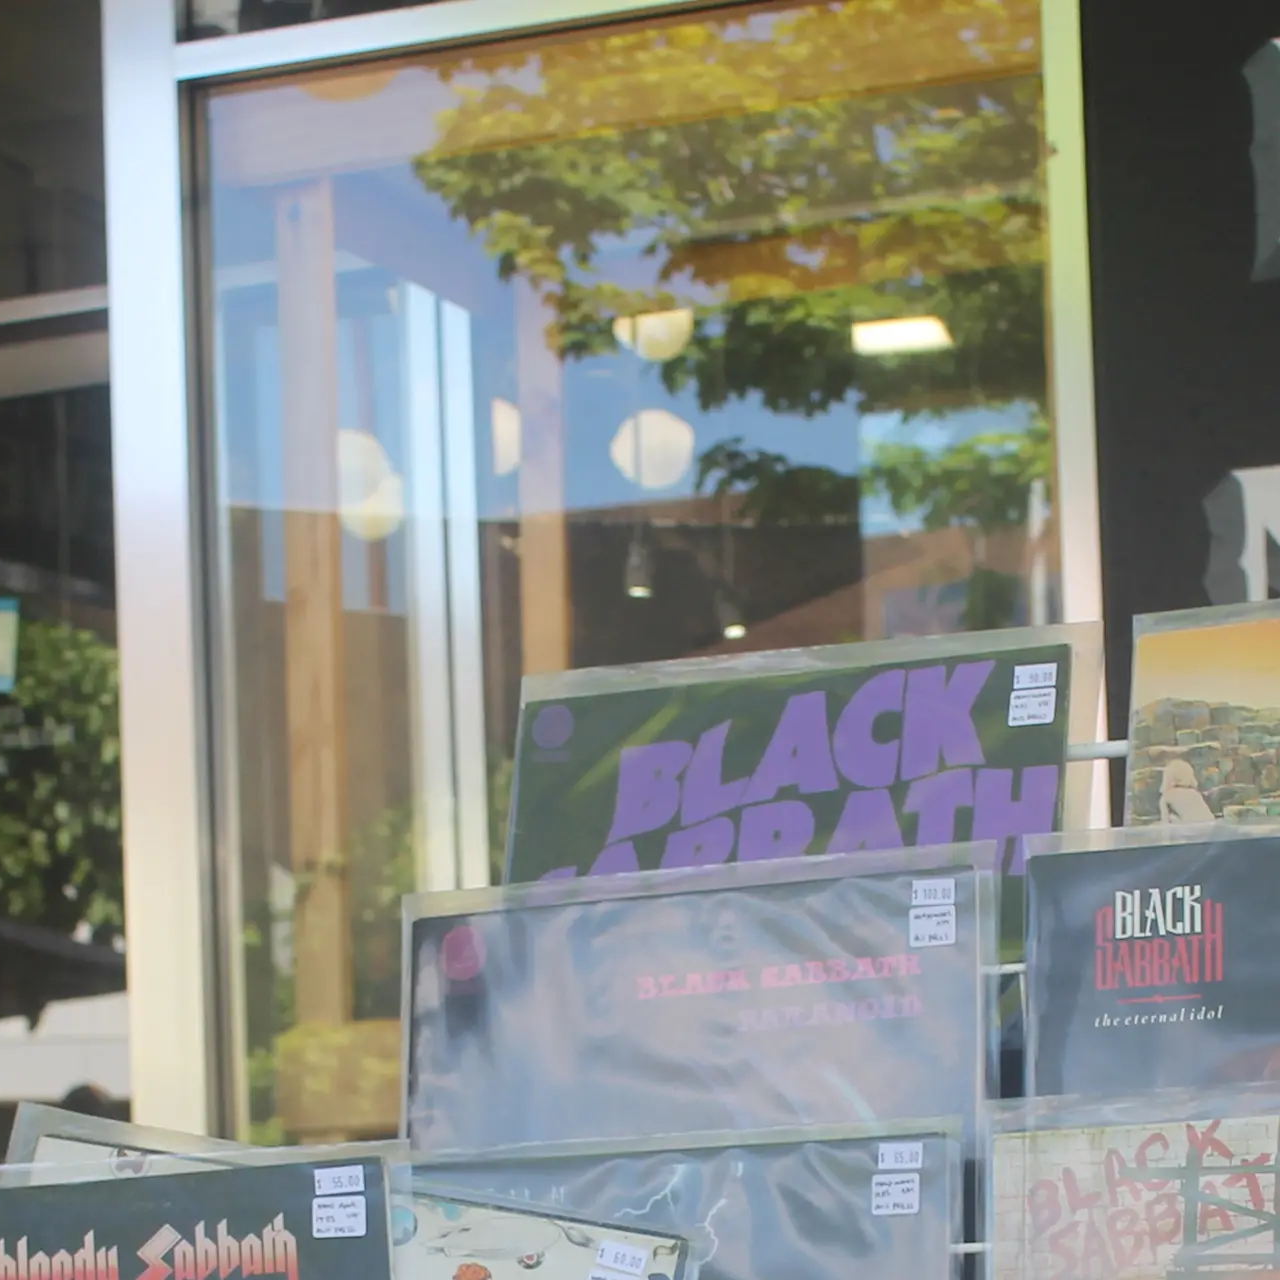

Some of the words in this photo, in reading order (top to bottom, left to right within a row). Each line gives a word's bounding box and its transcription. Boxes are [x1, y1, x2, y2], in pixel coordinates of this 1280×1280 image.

[611, 661, 995, 845] BLACK
[1114, 884, 1202, 939] BLACK
[1094, 898, 1224, 990] SABBATH
[635, 969, 750, 1000] BLACK
[760, 953, 922, 989] SABBATH
[1094, 1013, 1121, 1028] the
[1124, 1007, 1187, 1027] eternal
[1189, 1004, 1224, 1022] idol
